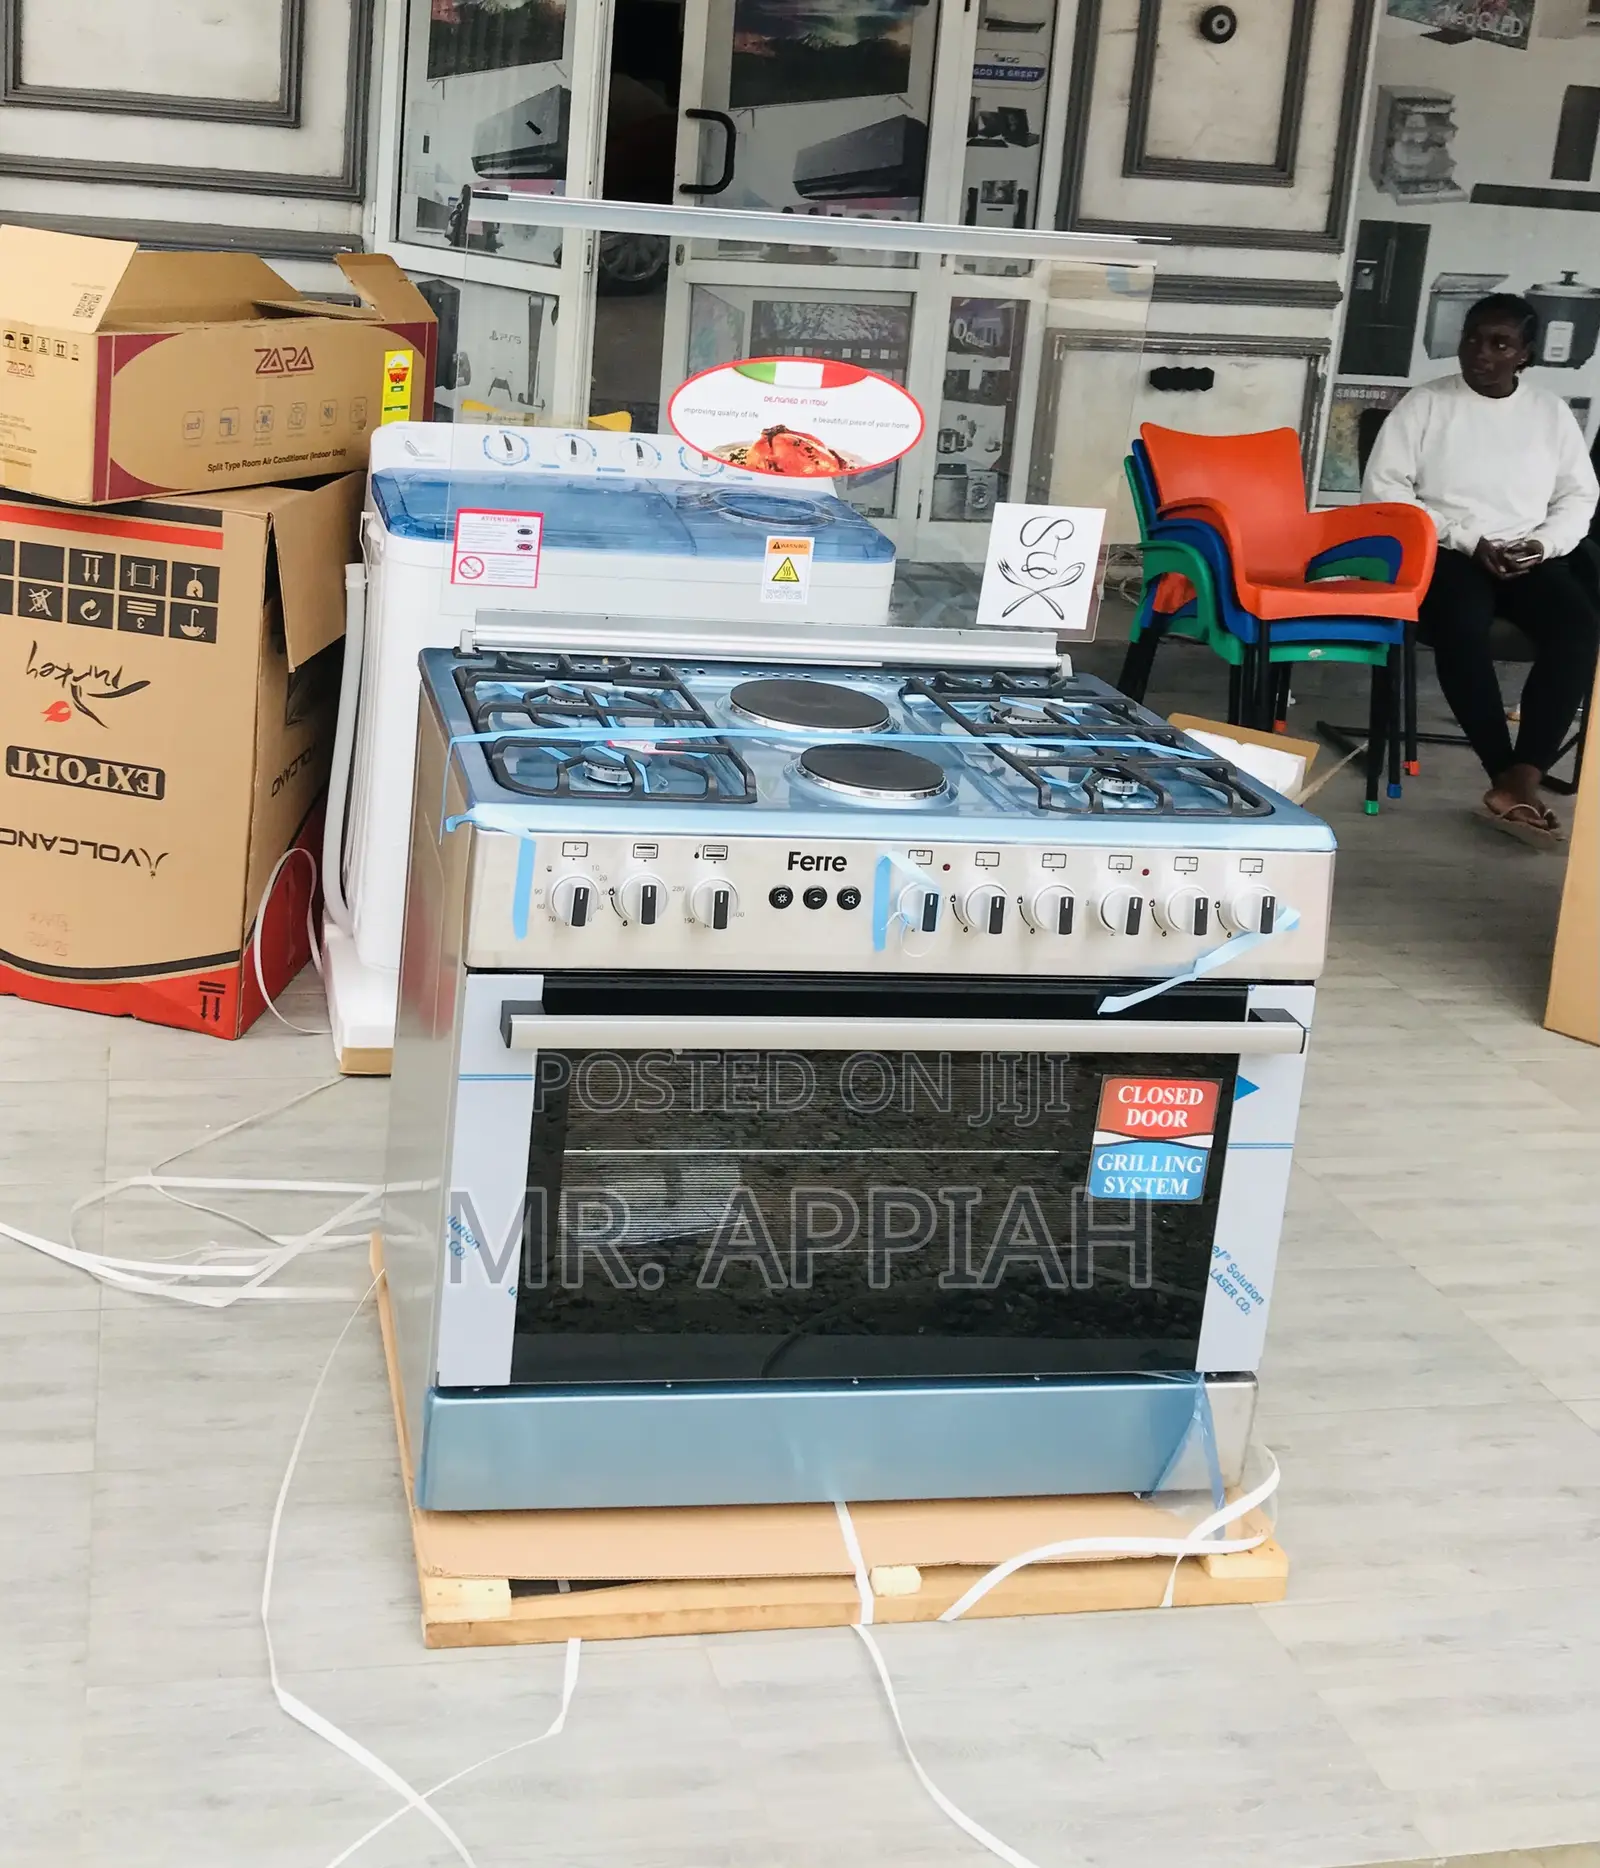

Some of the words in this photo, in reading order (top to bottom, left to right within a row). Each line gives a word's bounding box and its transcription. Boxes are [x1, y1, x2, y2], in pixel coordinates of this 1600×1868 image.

[6, 360, 35, 377] ZARA
[254, 346, 315, 374] ZARA
[1336, 388, 1387, 399] SAMSUNG
[684, 407, 716, 416] improving
[718, 410, 739, 418] quality
[892, 421, 910, 429] home
[207, 463, 224, 473] Split
[225, 461, 241, 471] Type
[242, 459, 261, 468] Room
[262, 457, 273, 465] Air
[273, 453, 309, 464] Conditioner
[310, 450, 332, 461] (Indoor
[332, 448, 347, 457] Unit)
[136, 617, 145, 629] 3
[26, 640, 151, 700] Turkey
[11, 750, 159, 797] EXPORT
[0, 827, 141, 867] VOLCANO
[787, 851, 848, 872] Ferre
[599, 874, 608, 882] 20
[1118, 1085, 1204, 1106] CLOSED
[1125, 1108, 1188, 1128] DOOR
[1097, 1153, 1203, 1174] GRILLING
[1103, 1176, 1189, 1196] SYSTEM
[1210, 1268, 1238, 1299] LASER
[1227, 1263, 1264, 1305] Solution
